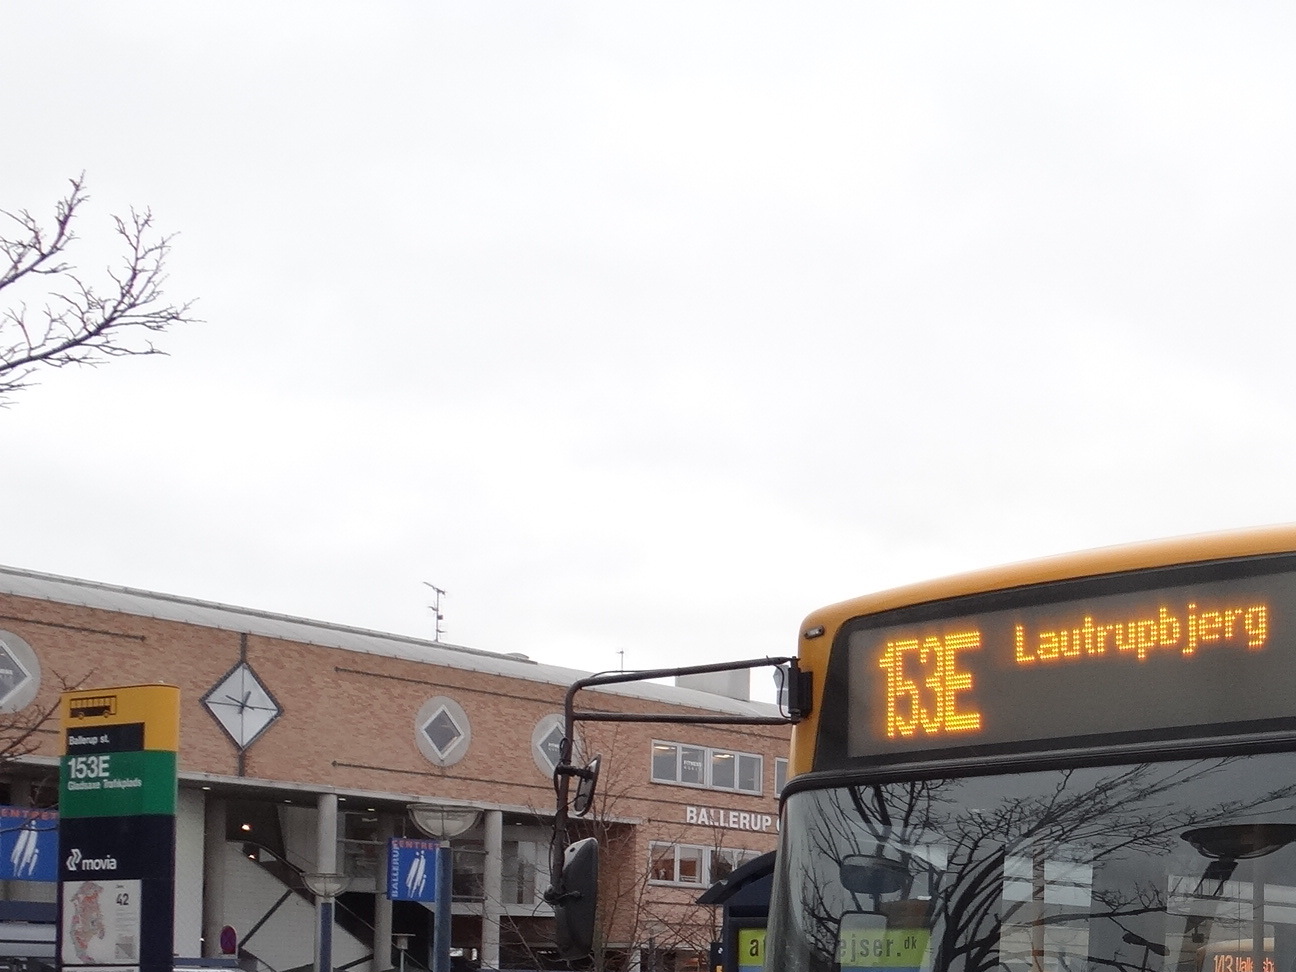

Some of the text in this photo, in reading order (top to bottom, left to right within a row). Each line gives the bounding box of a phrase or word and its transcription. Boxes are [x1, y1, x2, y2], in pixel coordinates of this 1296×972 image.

[878, 602, 1267, 738] 153E Lautrupbjerg
[68, 755, 110, 779] 153E
[686, 806, 772, 832] BALLERUP
[82, 854, 117, 870] movia
[116, 892, 129, 906] 42
